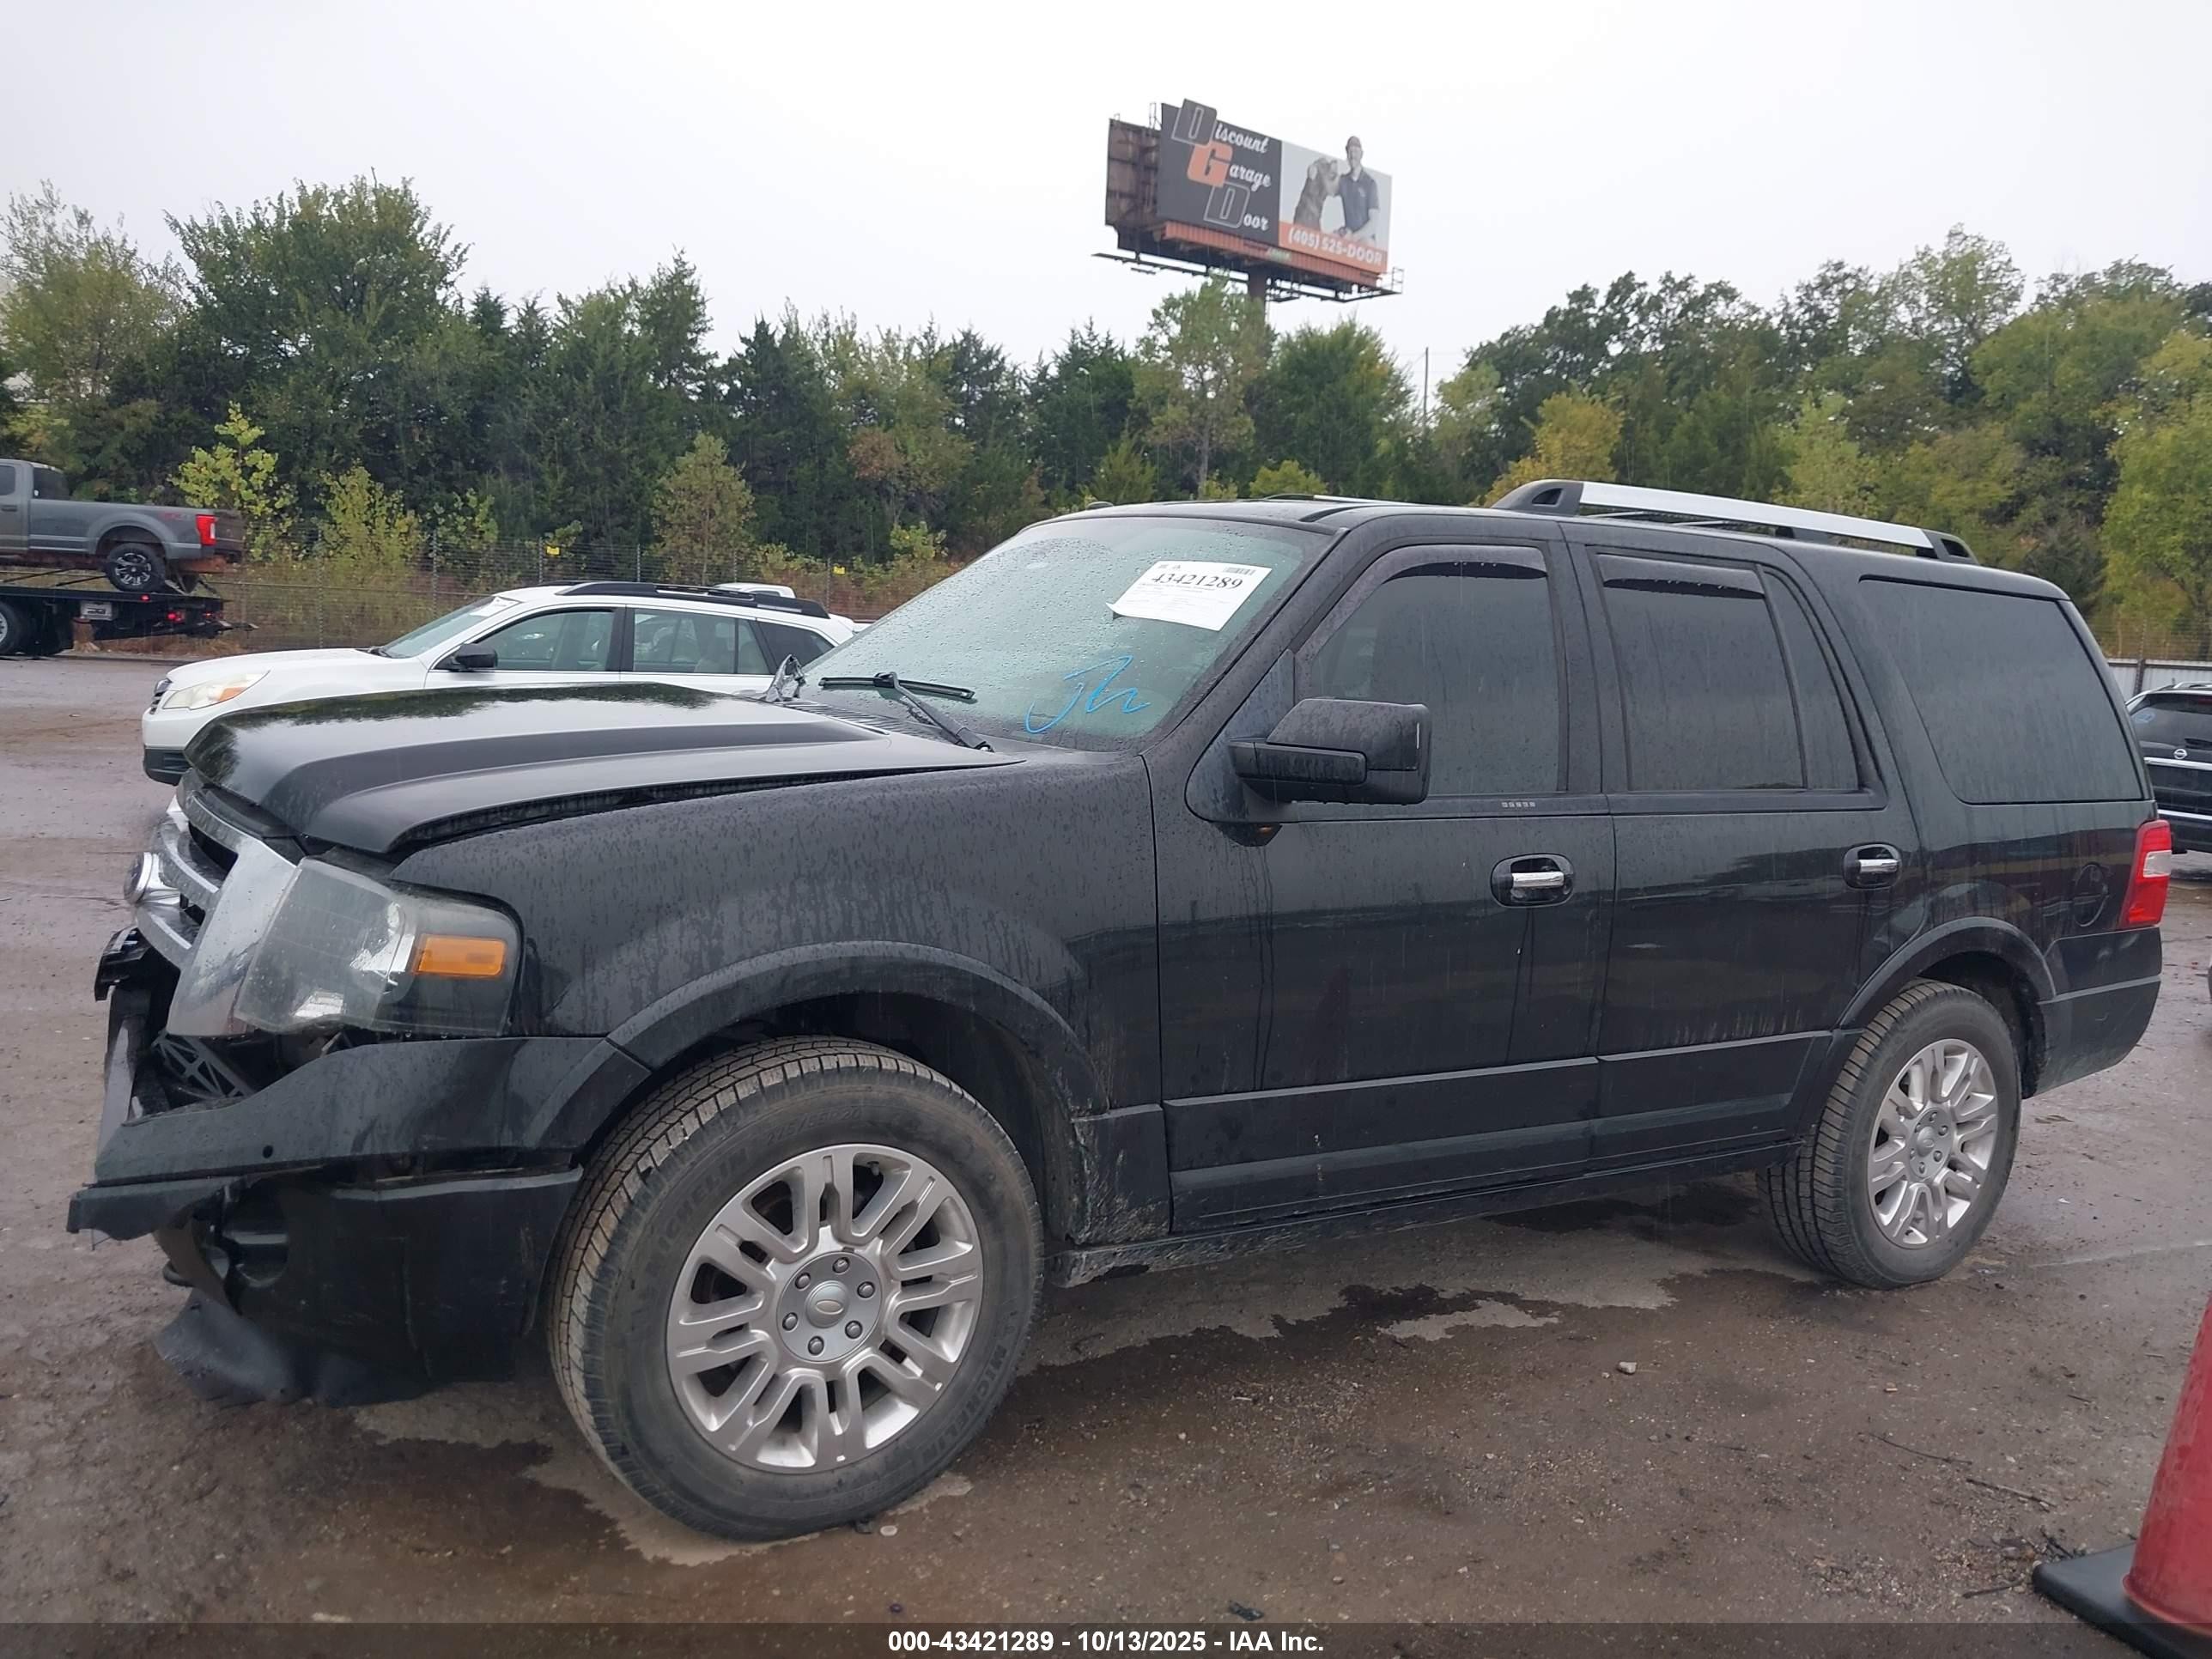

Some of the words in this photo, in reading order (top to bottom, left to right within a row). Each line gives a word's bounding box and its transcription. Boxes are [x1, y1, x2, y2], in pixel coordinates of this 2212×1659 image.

[1171, 100, 1269, 153] Discount
[1187, 139, 1271, 192] Garage
[1203, 181, 1269, 231] Door
[1151, 573, 1243, 590] 43421289
